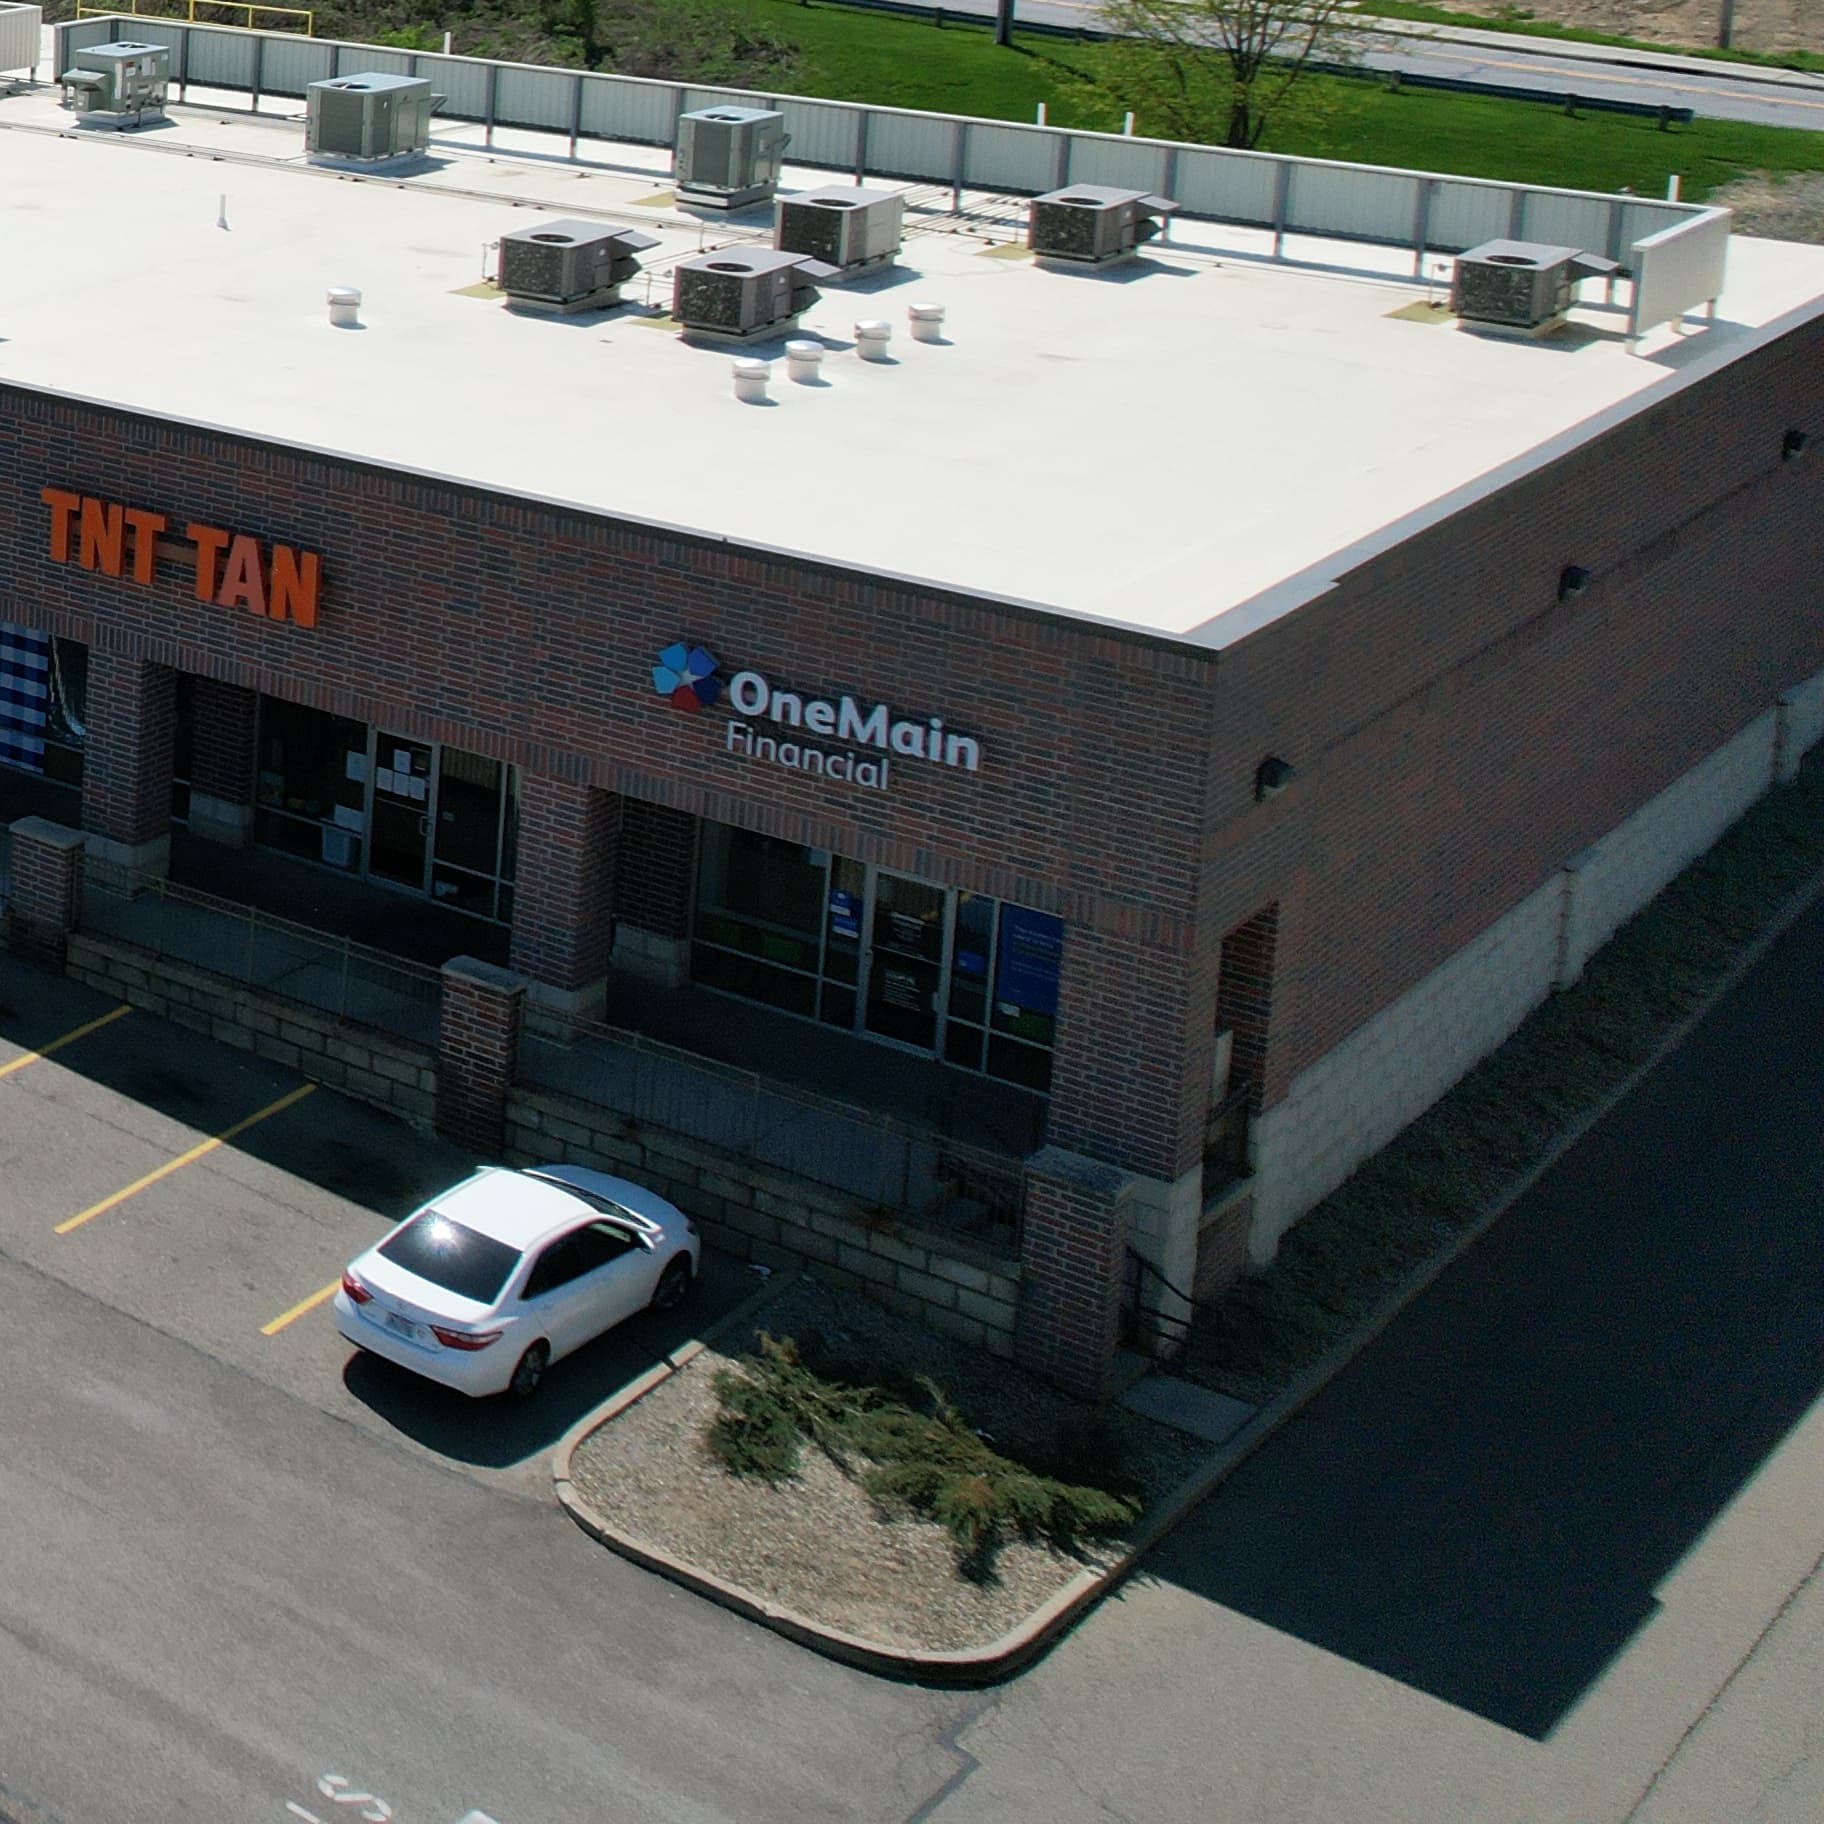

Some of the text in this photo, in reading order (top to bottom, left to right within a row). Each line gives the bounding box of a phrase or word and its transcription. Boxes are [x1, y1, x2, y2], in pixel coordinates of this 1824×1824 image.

[41, 486, 324, 629] TNT TAN
[725, 721, 890, 792] Financial
[729, 670, 982, 772] OneMain
